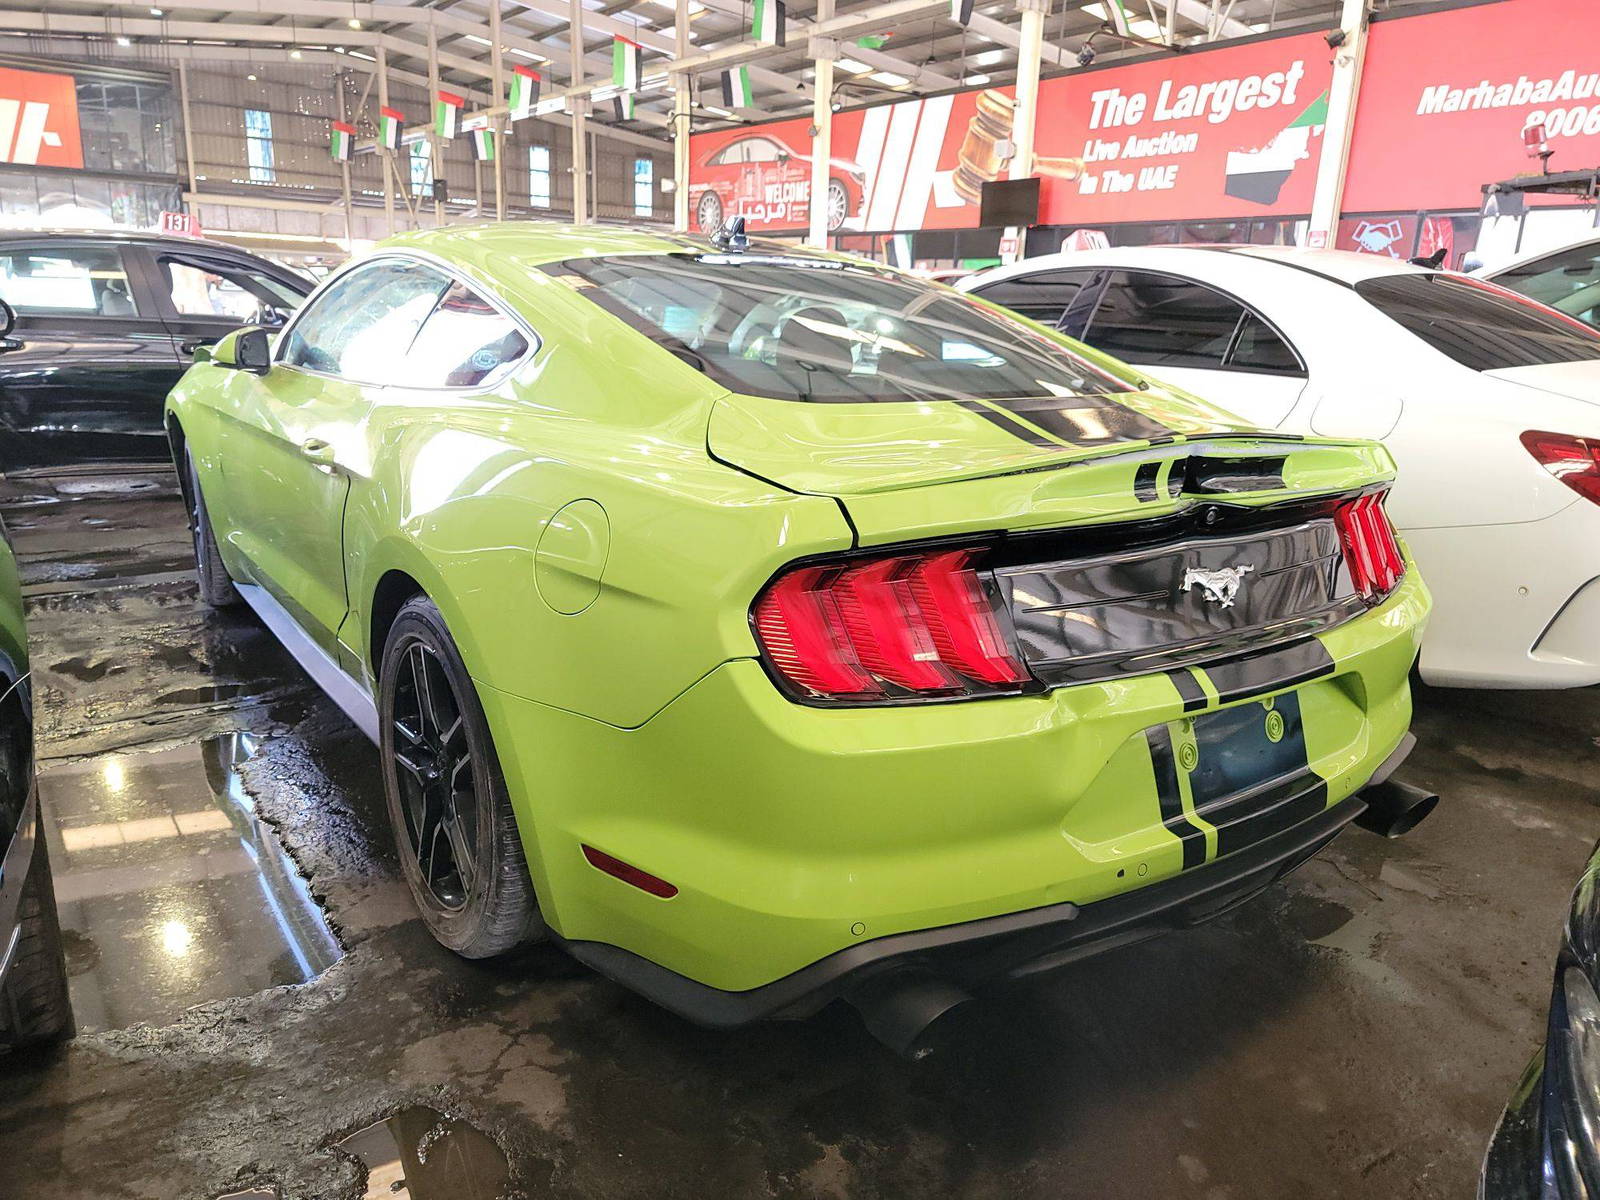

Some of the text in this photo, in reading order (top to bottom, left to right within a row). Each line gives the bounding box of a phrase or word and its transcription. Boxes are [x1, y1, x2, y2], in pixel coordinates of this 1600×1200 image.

[1089, 60, 1304, 130] The Largest
[1416, 70, 1600, 116] MarhabaAu
[1083, 130, 1199, 162] Live Auction
[765, 181, 811, 204] WELCOME
[1078, 165, 1180, 195] In The UAE
[166, 213, 189, 233] 131
